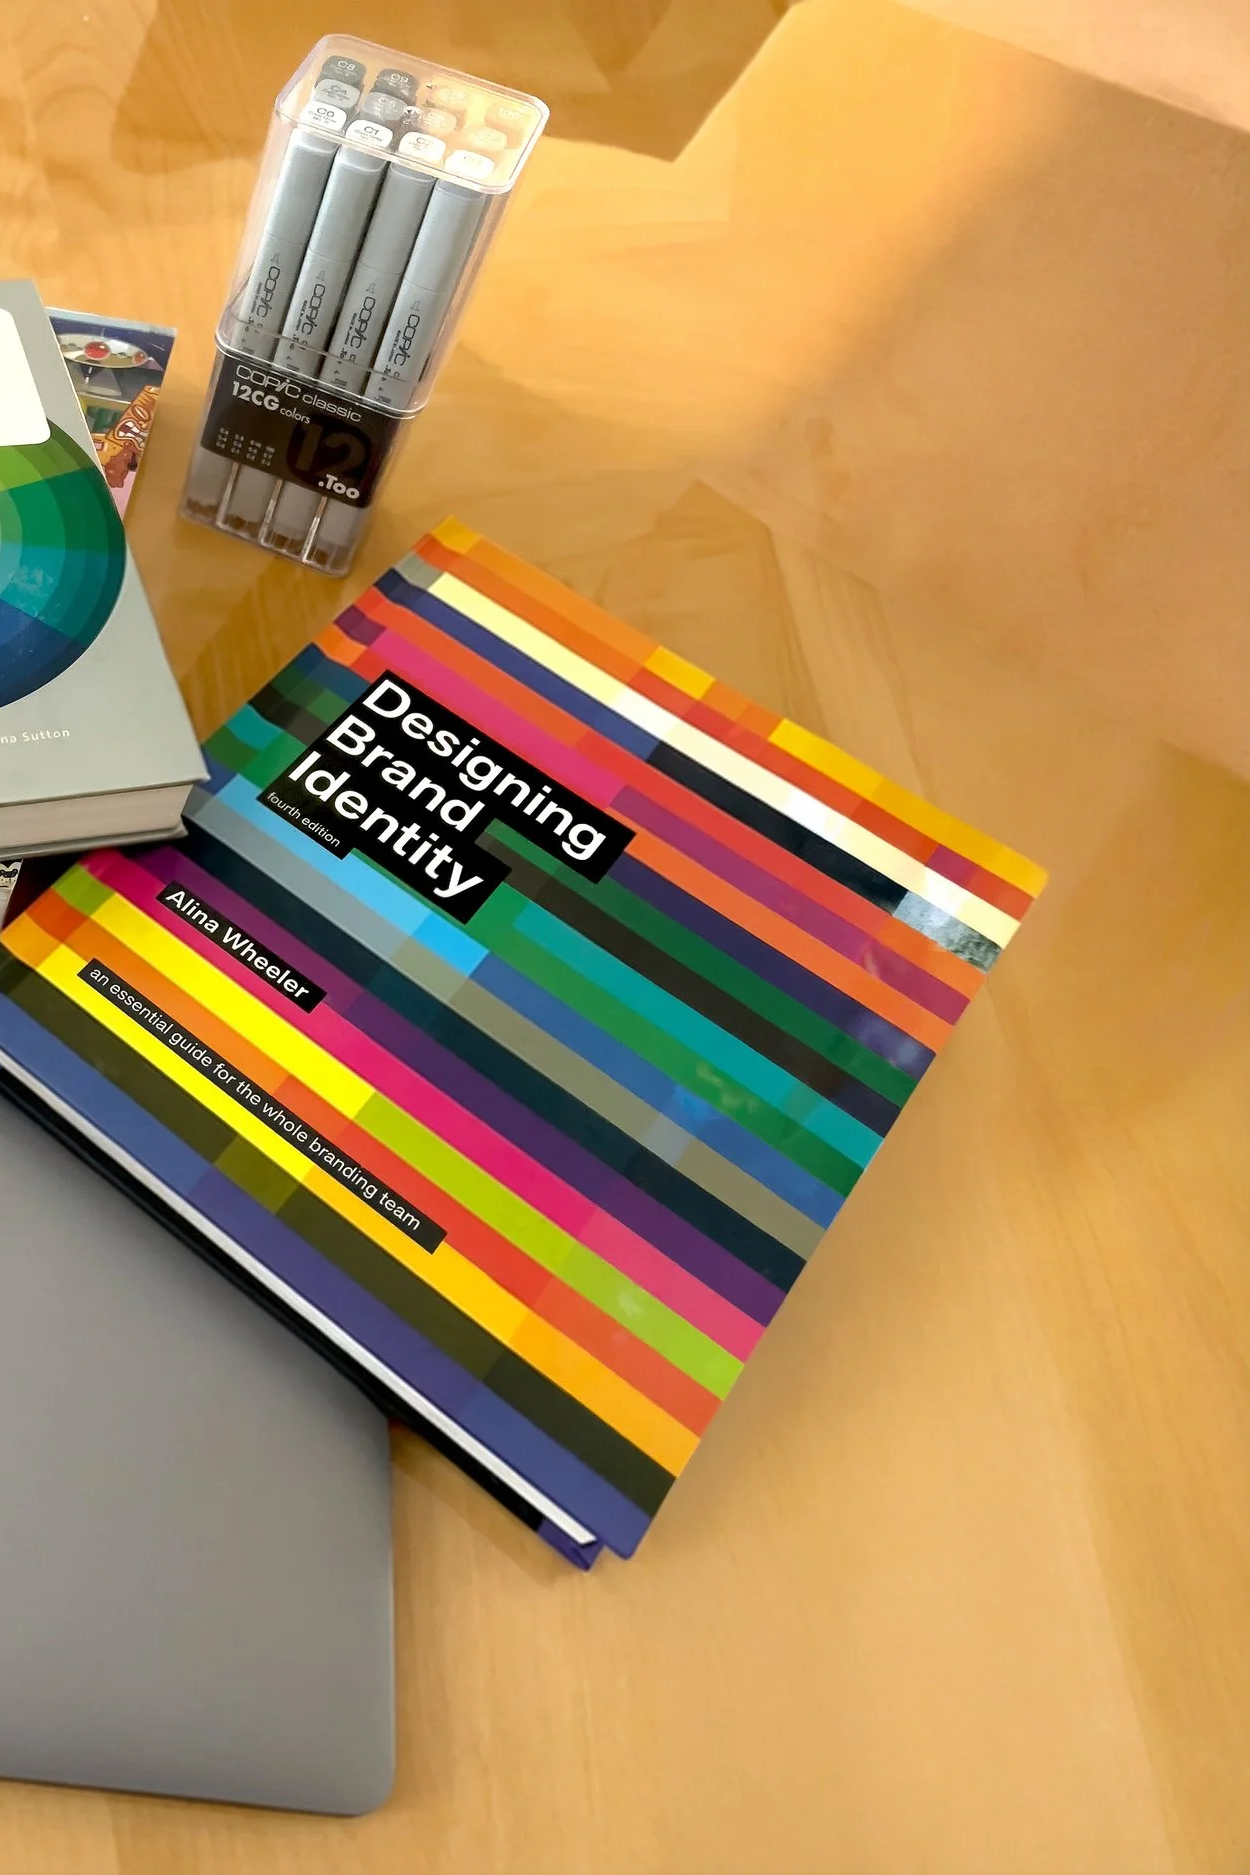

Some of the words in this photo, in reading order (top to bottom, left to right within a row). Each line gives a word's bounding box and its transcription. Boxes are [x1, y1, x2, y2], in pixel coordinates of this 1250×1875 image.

[317, 107, 334, 118] C0
[364, 126, 379, 135] C1
[231, 381, 280, 411] 12CG
[280, 406, 311, 424] colors
[302, 392, 362, 422] classic
[296, 422, 365, 481] 12
[318, 473, 360, 499] .Too
[22, 729, 70, 742] Sutton
[326, 714, 485, 832] Brand
[362, 678, 607, 861] Designing
[267, 791, 301, 819] fourth
[301, 817, 341, 847] edition
[287, 750, 484, 898] Identity
[166, 890, 219, 934] Alina
[222, 926, 309, 998] Wheeler
[90, 968, 110, 986] an
[109, 982, 174, 1035] essential
[168, 1032, 213, 1067] guide
[212, 1063, 237, 1084] for
[236, 1081, 261, 1105] the
[262, 1102, 308, 1143] whole
[308, 1137, 378, 1199] branding
[379, 1192, 421, 1231] team
